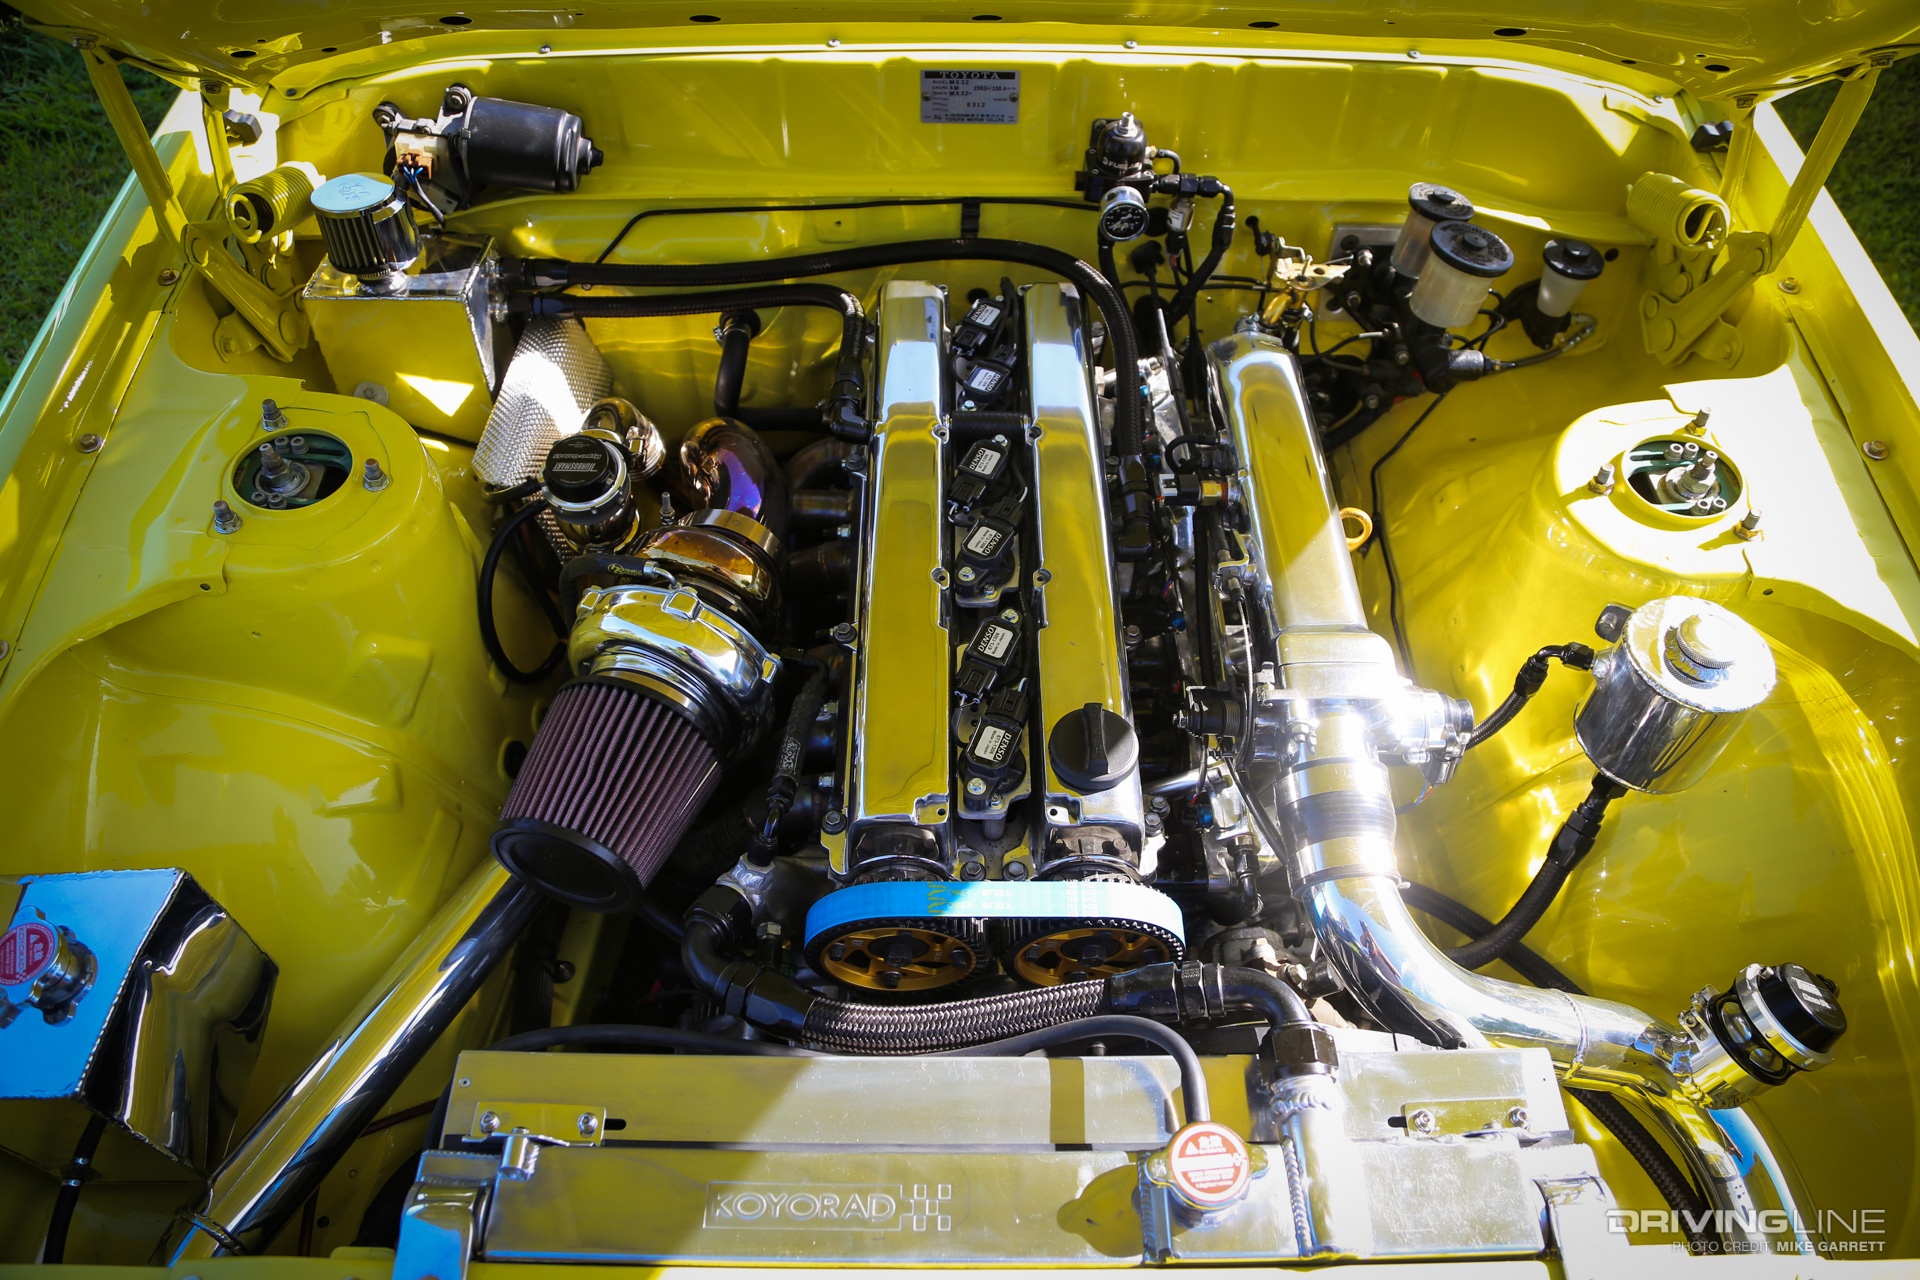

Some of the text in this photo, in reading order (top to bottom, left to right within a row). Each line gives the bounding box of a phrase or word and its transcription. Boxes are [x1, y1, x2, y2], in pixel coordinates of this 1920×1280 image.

[940, 71, 1000, 79] TOYOTA
[971, 304, 987, 320] DENSO
[987, 374, 1000, 391] DENSO
[552, 462, 597, 472] TURBOSMART
[969, 450, 984, 470] DENSO
[985, 533, 1002, 554] DENSO
[978, 627, 994, 651] DENSO
[996, 733, 1012, 760] DENSO
[711, 1191, 896, 1221] KOYORAD
